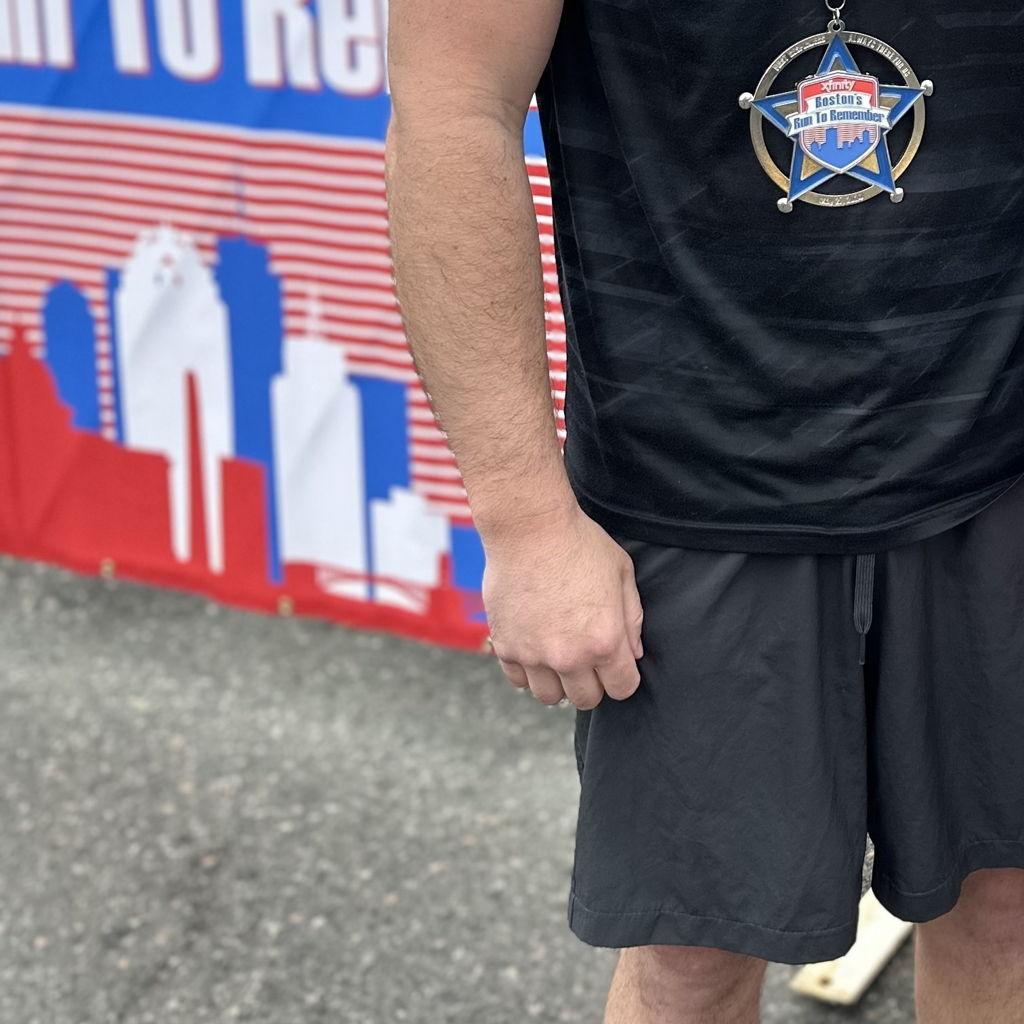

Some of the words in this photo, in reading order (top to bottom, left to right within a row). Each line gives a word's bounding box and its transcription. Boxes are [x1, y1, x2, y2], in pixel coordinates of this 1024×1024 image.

[820, 79, 856, 92] xfinity
[815, 93, 862, 108] Boston's
[794, 116, 813, 130] Run
[816, 111, 827, 124] To
[830, 109, 885, 123] Remember
